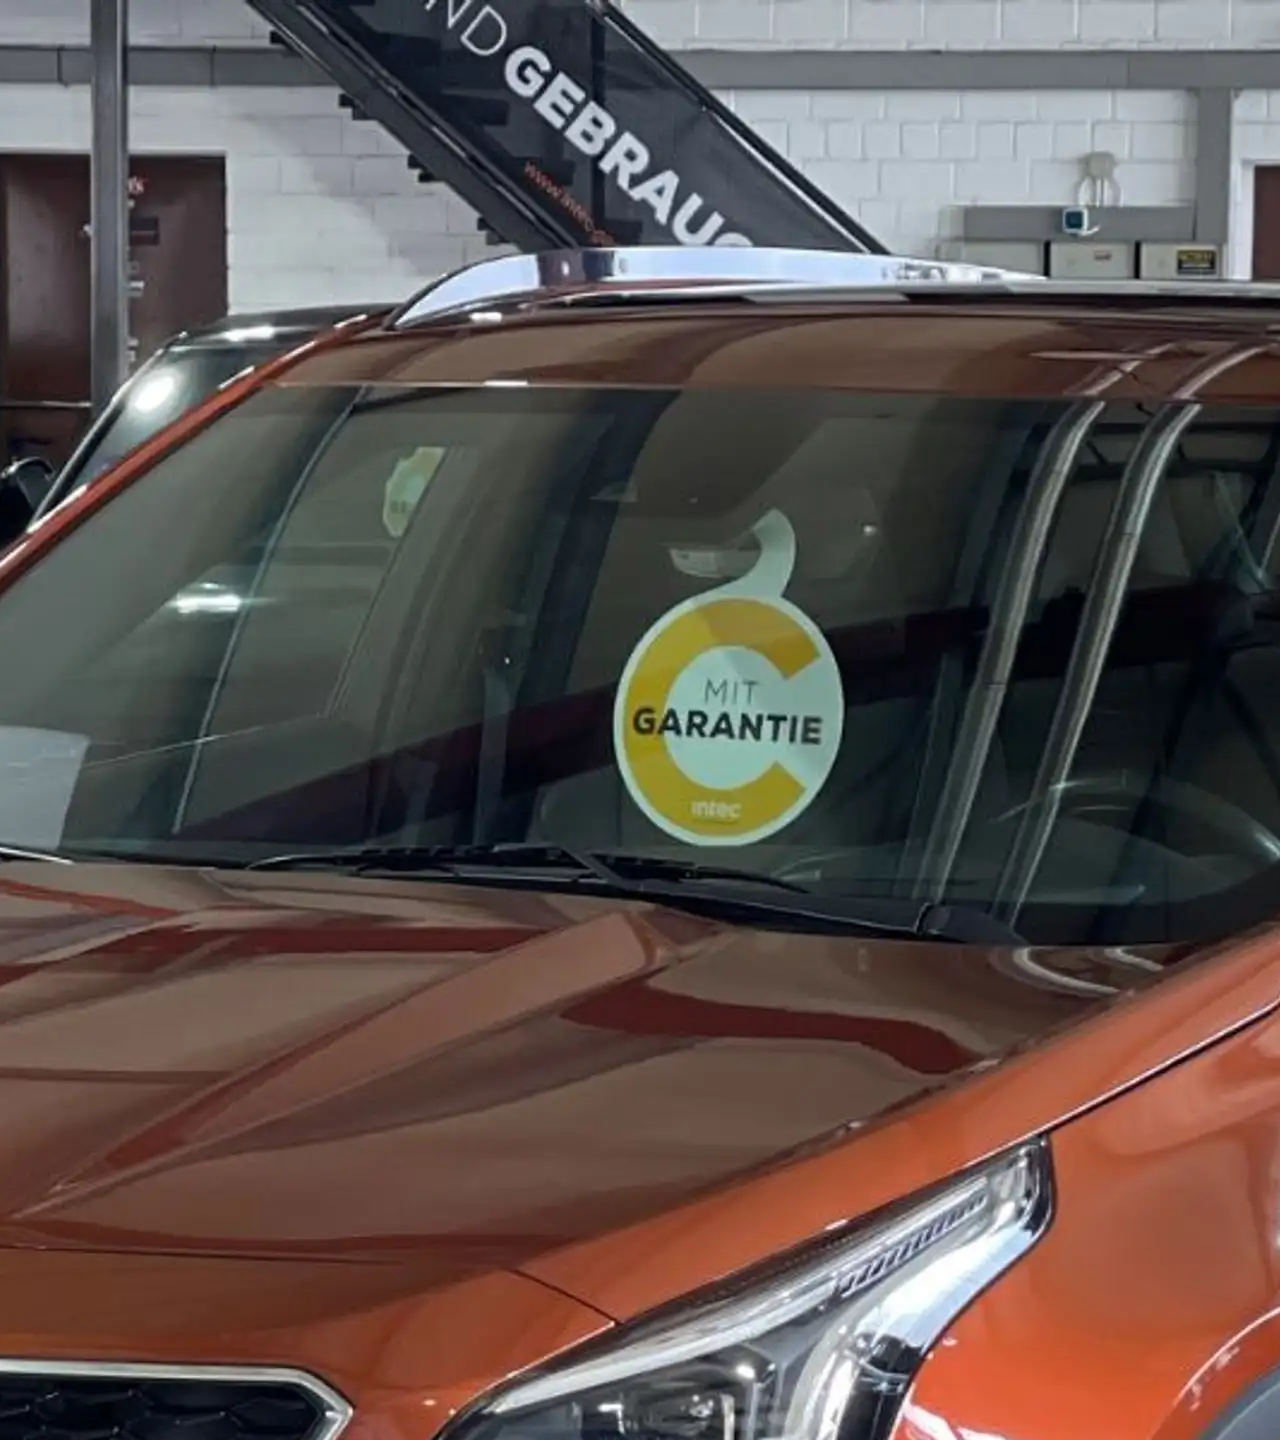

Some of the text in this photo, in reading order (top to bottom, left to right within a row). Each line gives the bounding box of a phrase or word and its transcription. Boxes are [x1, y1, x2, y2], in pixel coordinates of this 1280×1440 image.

[503, 45, 754, 248] GEBRAU
[704, 678, 761, 705] MIT
[632, 707, 824, 746] GARANTIE
[692, 799, 743, 821] intec
